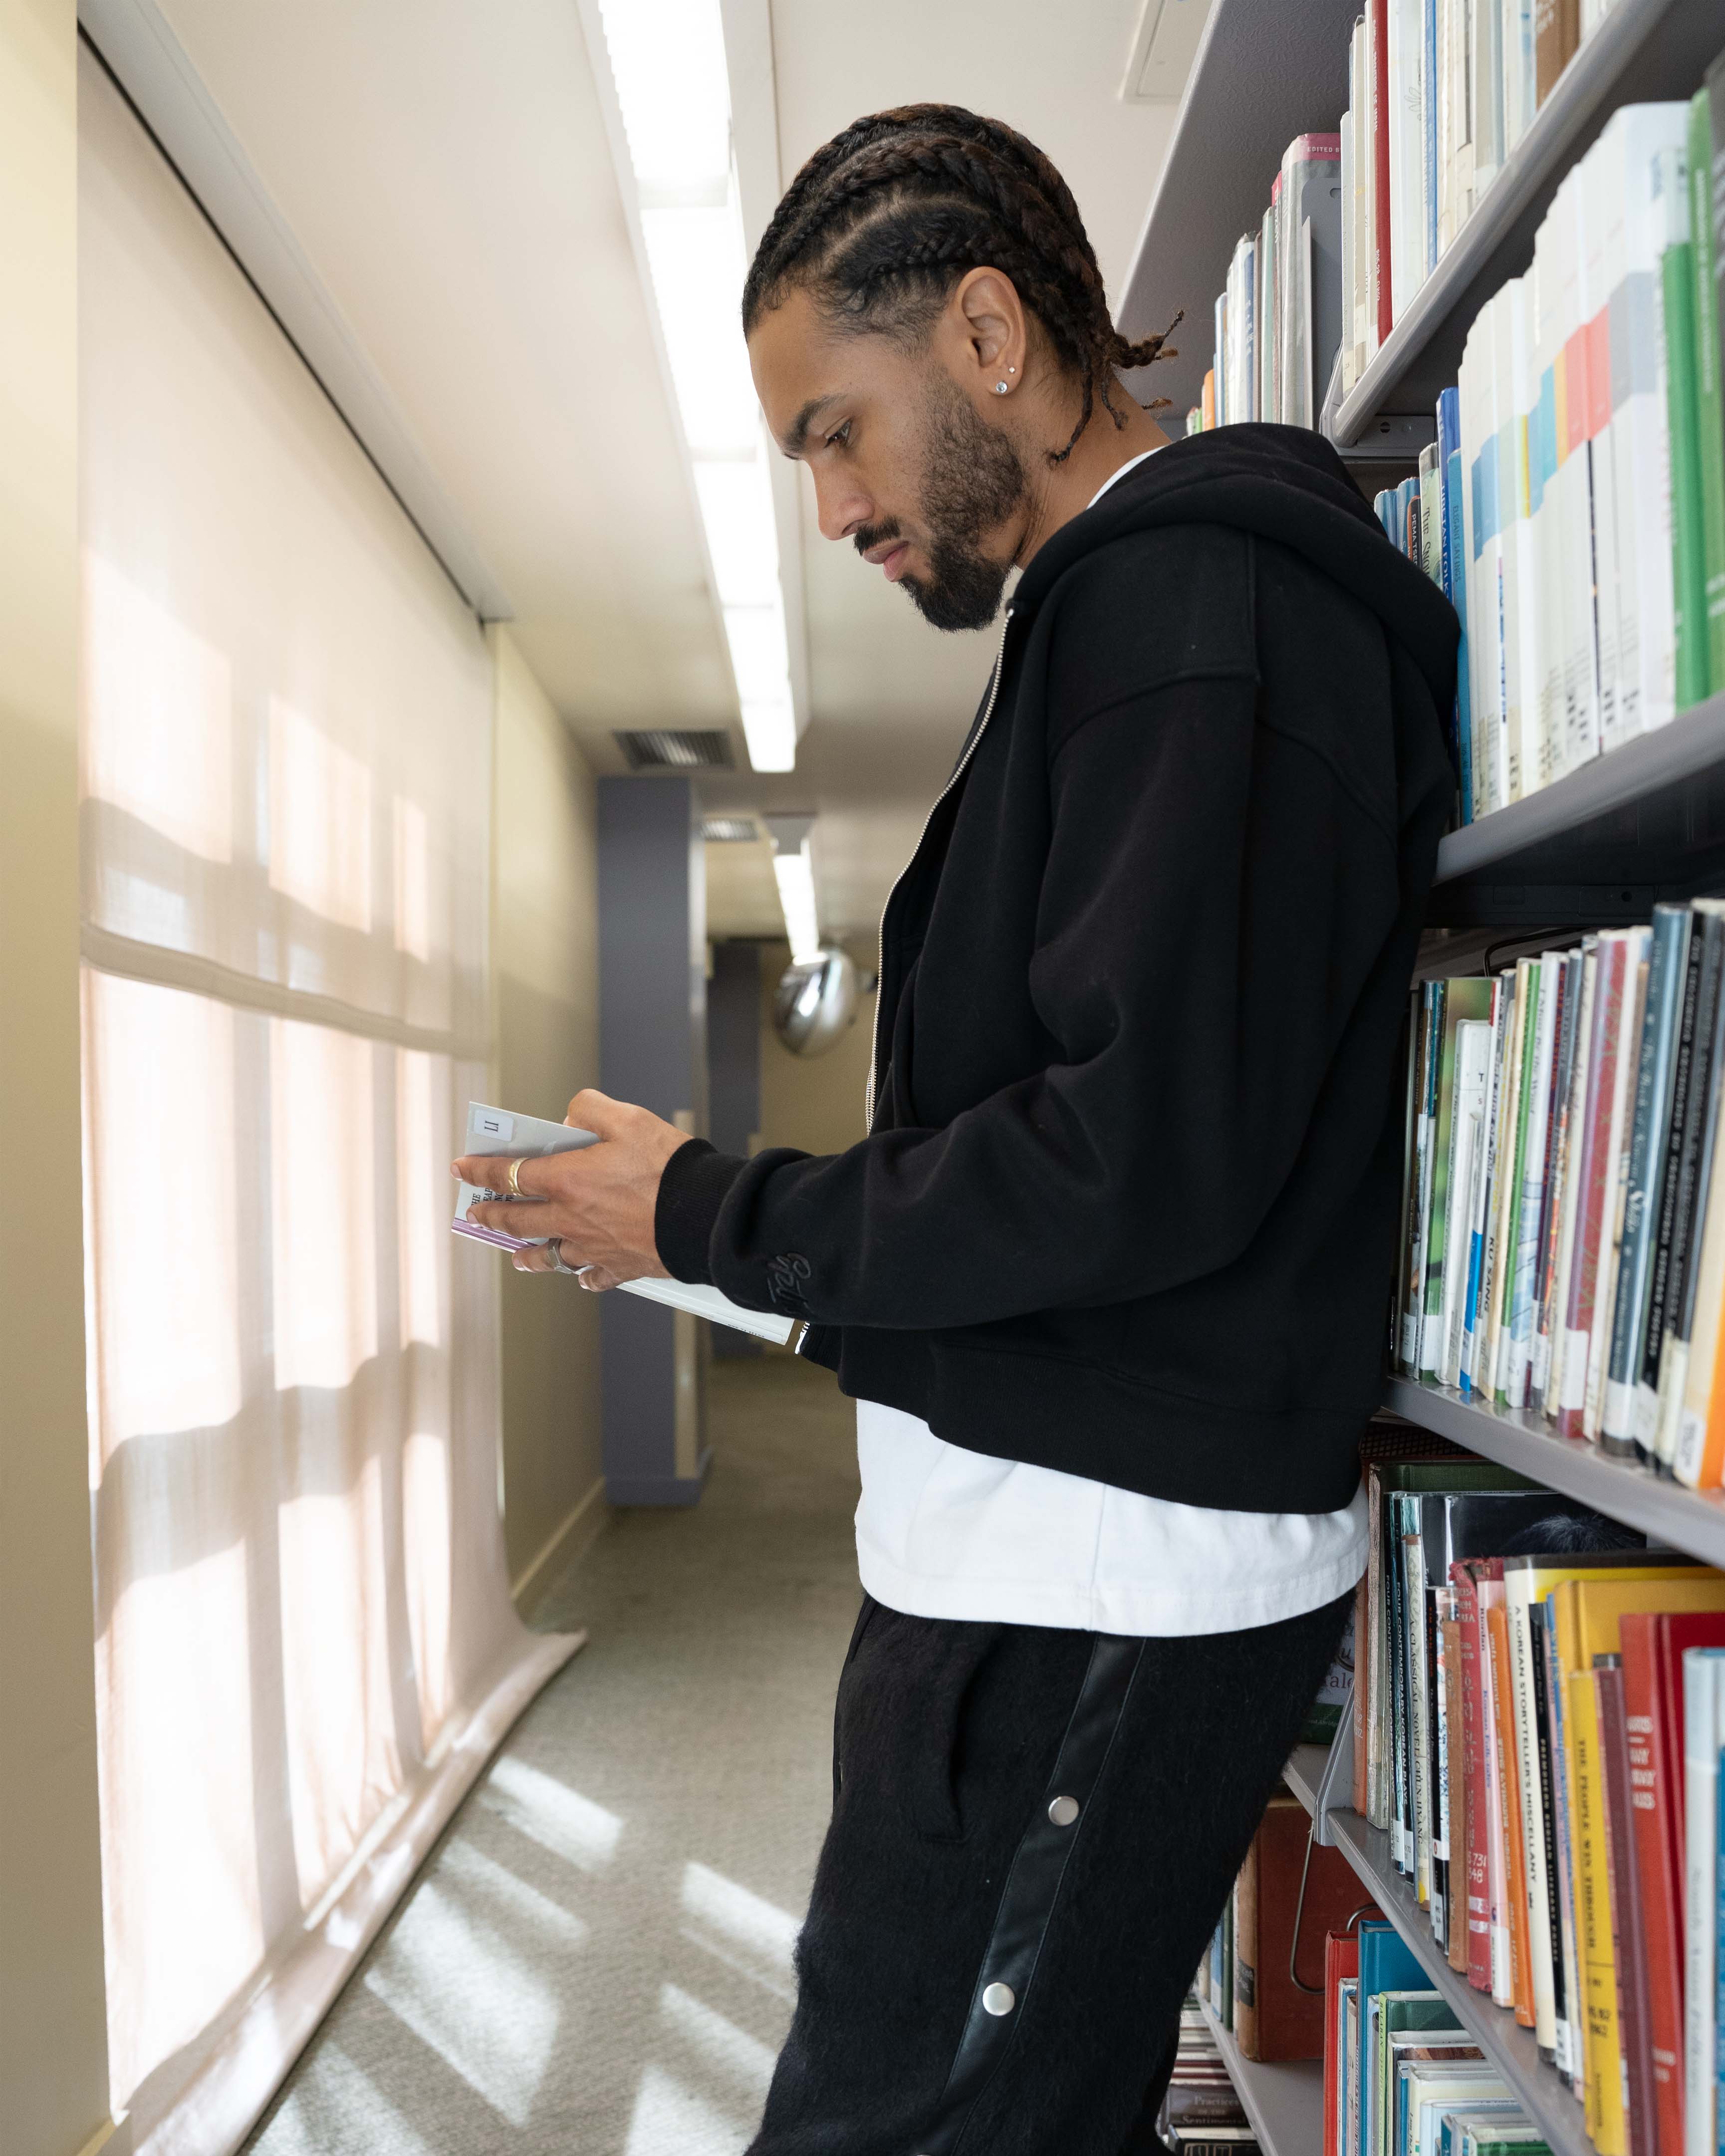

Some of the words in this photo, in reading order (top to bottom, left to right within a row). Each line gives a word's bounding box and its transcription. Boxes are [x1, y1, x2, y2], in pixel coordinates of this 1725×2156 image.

[1479, 1073, 1484, 1083] T
[484, 1121, 499, 1132] LI
[1487, 1236, 1494, 1261] KU
[1483, 1266, 1492, 1313] SANG
[1515, 1606, 1521, 1615] A
[1410, 1633, 1418, 1706] CLASSICAL
[1516, 1620, 1526, 1677] KOREAN
[1519, 1682, 1532, 1789] STORYTELLER'S
[1525, 1793, 1537, 1883] MISCELLANY
